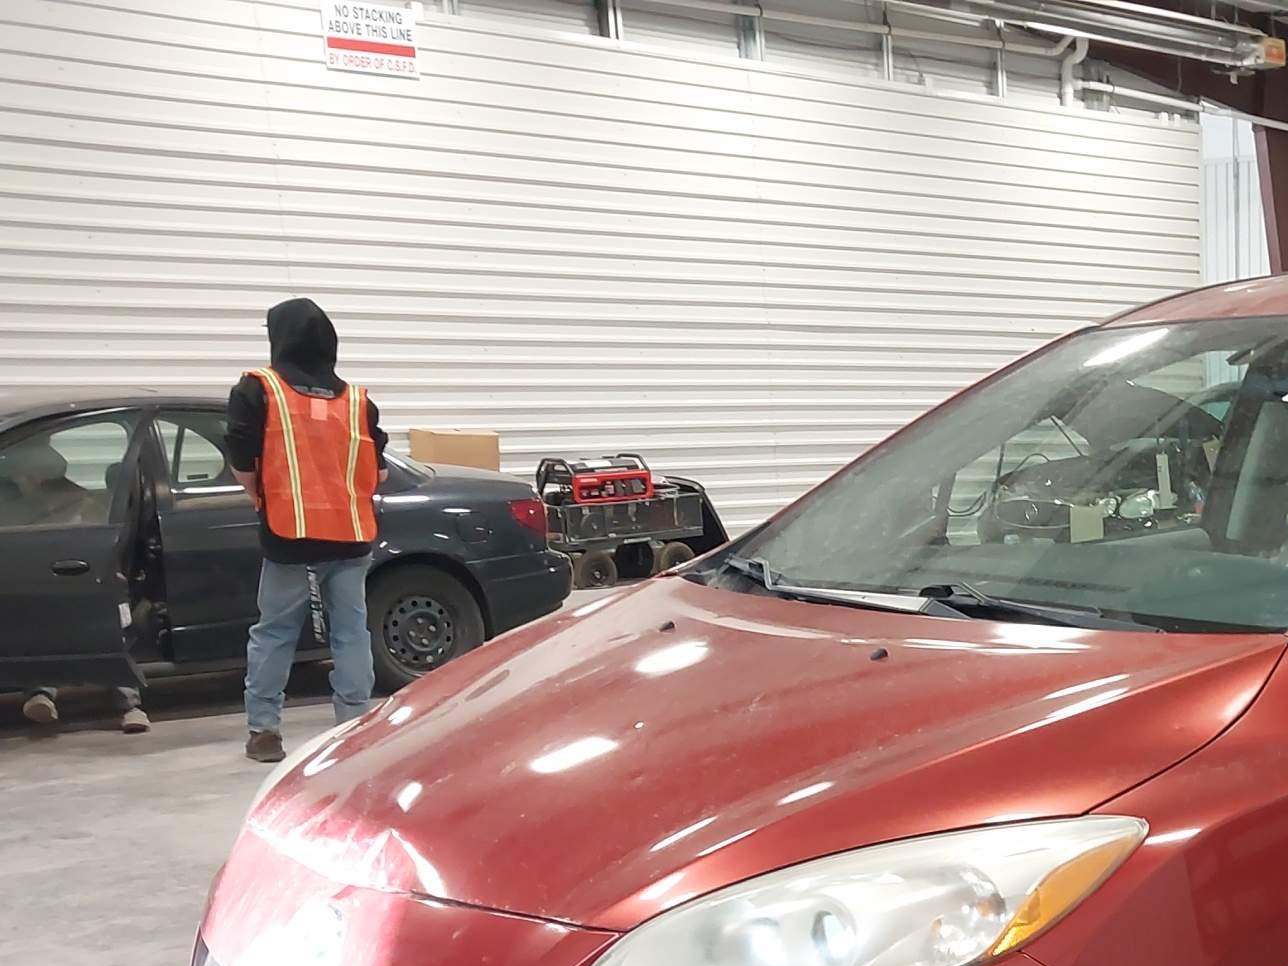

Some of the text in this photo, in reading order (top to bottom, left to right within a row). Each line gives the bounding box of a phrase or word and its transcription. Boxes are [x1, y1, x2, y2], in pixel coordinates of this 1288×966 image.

[334, 4, 403, 25] NO STACKING
[328, 19, 413, 42] ABOVE THIS LINE
